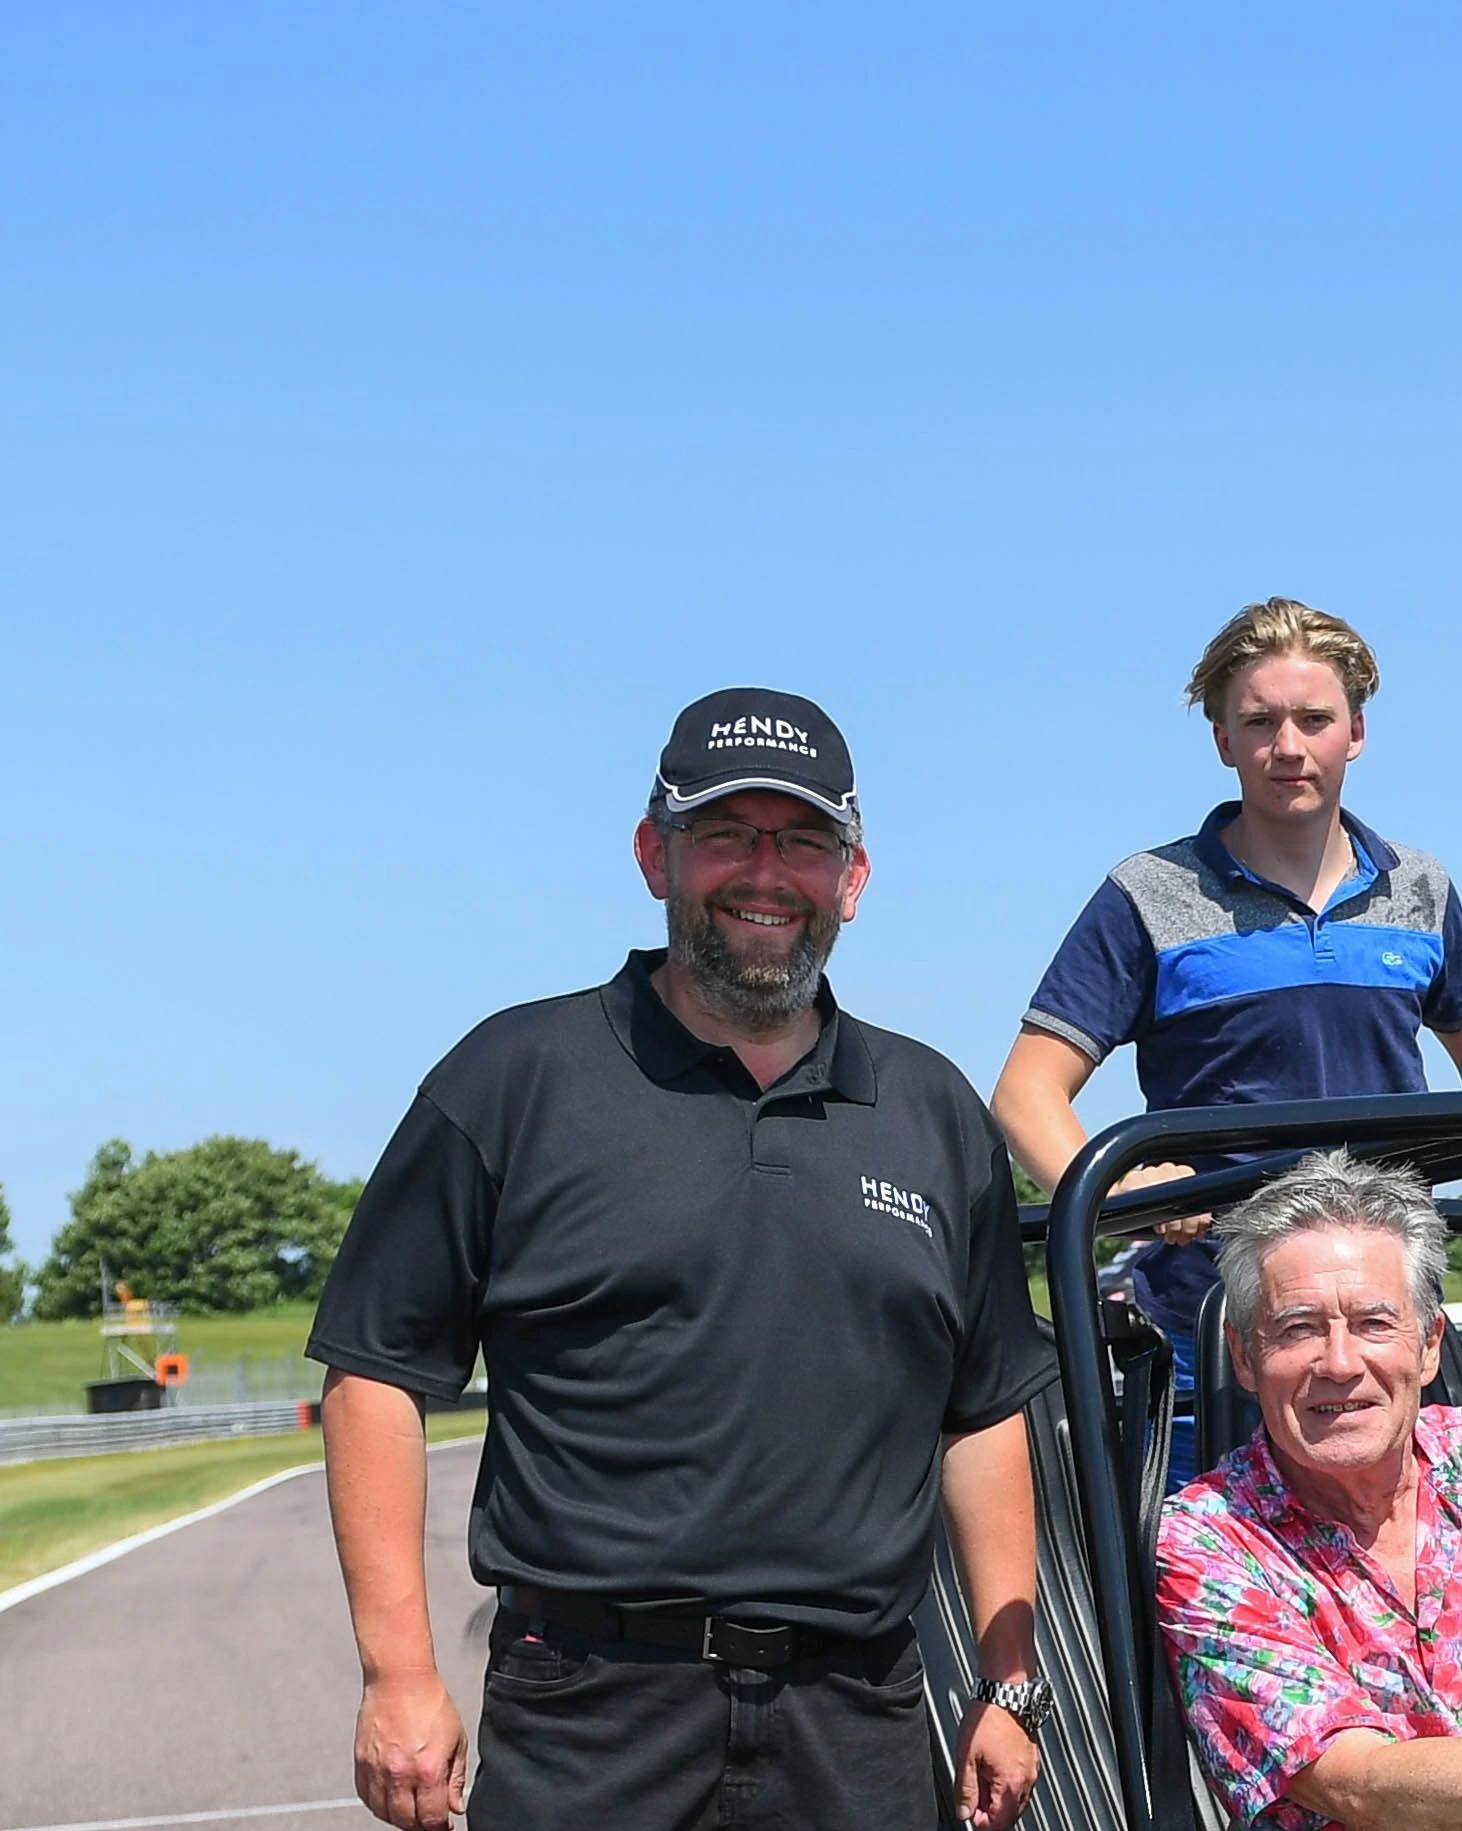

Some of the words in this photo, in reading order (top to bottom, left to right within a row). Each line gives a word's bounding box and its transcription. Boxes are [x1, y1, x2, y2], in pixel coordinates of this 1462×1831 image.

[711, 715, 808, 743] HENDY
[708, 737, 817, 758] PERFORMANCE
[861, 1175, 931, 1222] HENDY
